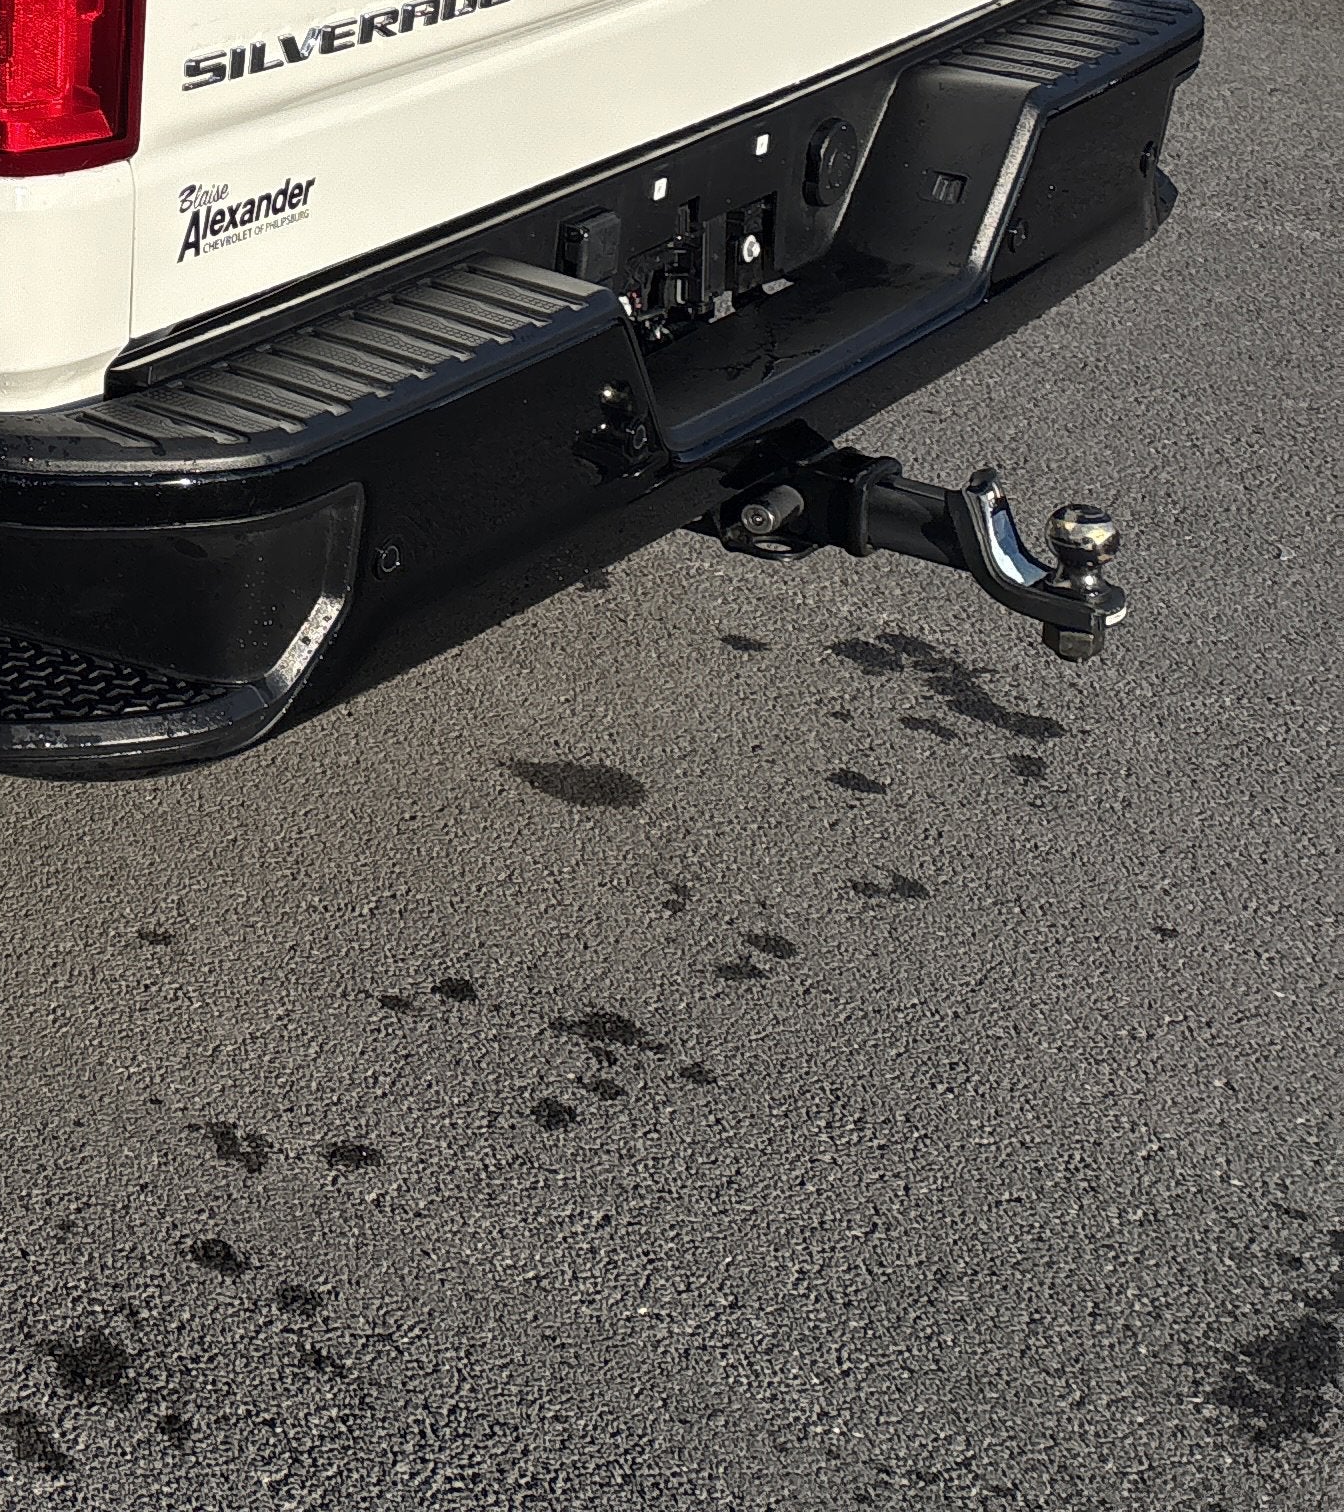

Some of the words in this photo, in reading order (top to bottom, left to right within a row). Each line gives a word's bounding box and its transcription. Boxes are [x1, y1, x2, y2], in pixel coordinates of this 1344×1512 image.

[178, 183, 229, 214] Blaise
[177, 177, 316, 264] Alexander
[202, 227, 253, 254] CHEVROLET
[254, 223, 265, 236] OF
